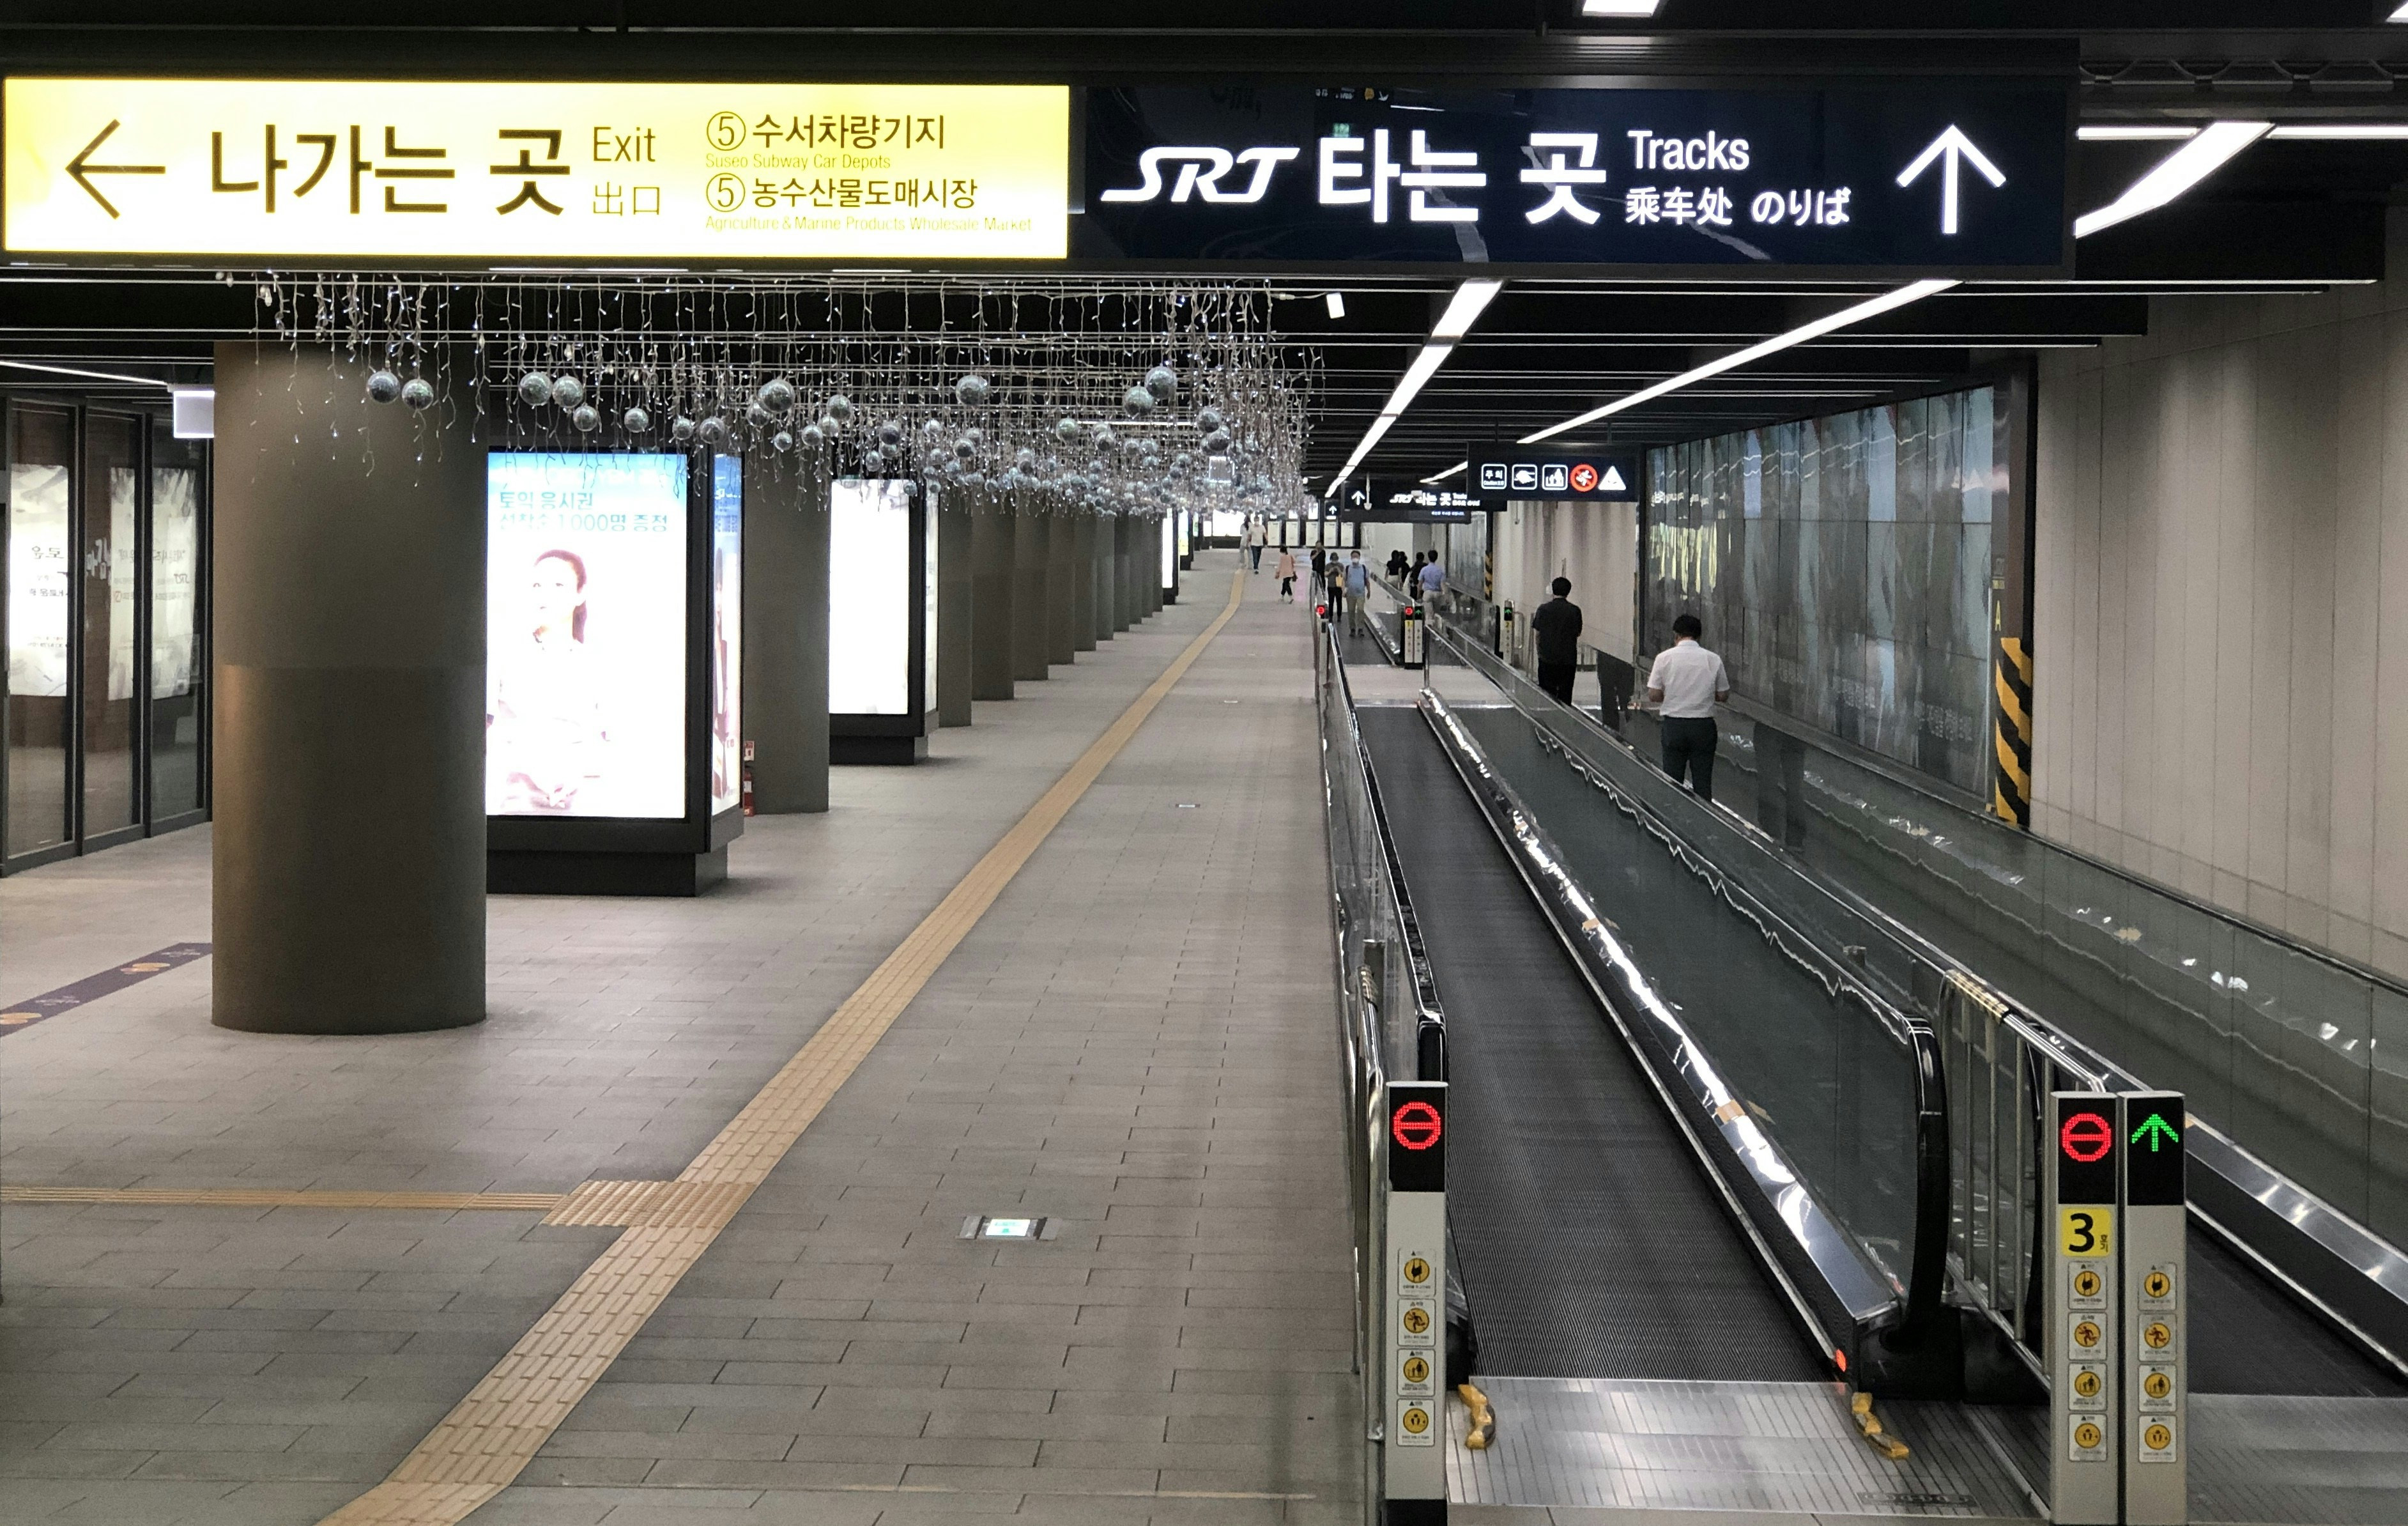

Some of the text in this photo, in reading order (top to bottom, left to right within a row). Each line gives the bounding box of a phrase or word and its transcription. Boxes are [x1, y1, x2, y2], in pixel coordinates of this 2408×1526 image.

[594, 127, 656, 162] Exit
[753, 114, 944, 150] 수서차량기지
[706, 154, 891, 171] Suseo Subway Car Depots
[1627, 130, 1750, 171] Tracks
[213, 125, 570, 215] 나가는 곳
[1101, 125, 1607, 225] SRT 타는 곳
[593, 181, 661, 217] 出口
[752, 178, 978, 209] 농수산물도매시장
[1625, 186, 1852, 226] 乘车处 のりば
[705, 216, 779, 231] Agriculture
[795, 216, 841, 230] Marine
[847, 216, 905, 230] Products
[910, 216, 979, 231] Wholesale
[985, 217, 1032, 231] Market
[500, 491, 594, 510] 토익 응시권
[633, 514, 668, 532] 증정
[2068, 1213, 2094, 1253] 3
